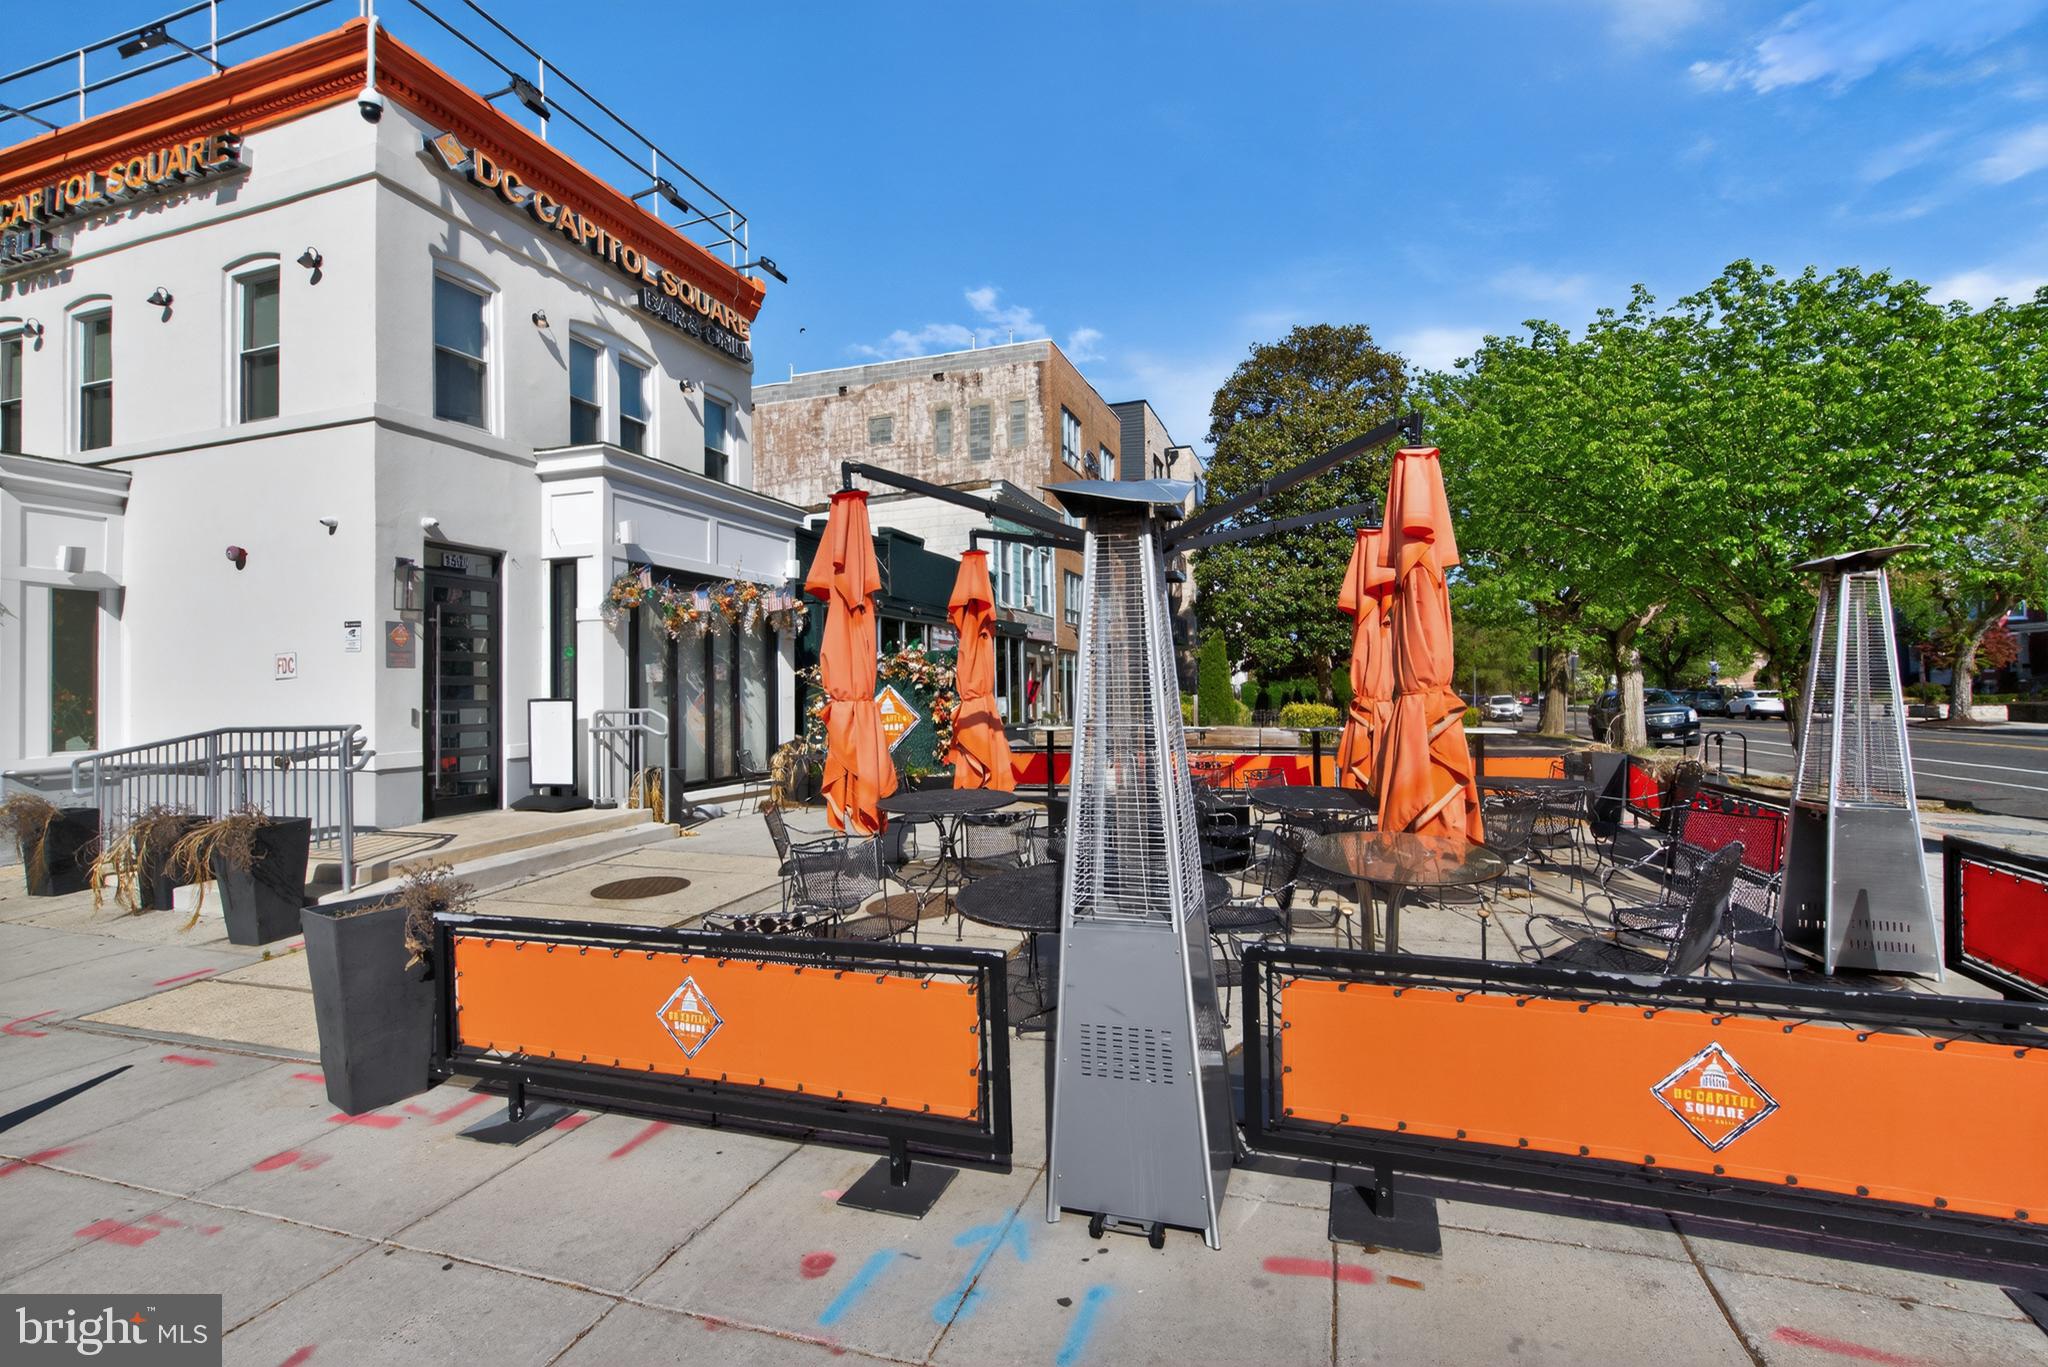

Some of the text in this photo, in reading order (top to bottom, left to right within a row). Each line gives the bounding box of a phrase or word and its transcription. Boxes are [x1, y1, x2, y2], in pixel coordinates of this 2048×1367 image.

[106, 135, 231, 193] SQUARE
[474, 148, 750, 341] DC CAPITOL SQUARE
[277, 657, 295, 674] FDC
[1673, 1088, 1757, 1109] DC CAPITOL
[1685, 1101, 1745, 1120] SQUARE
